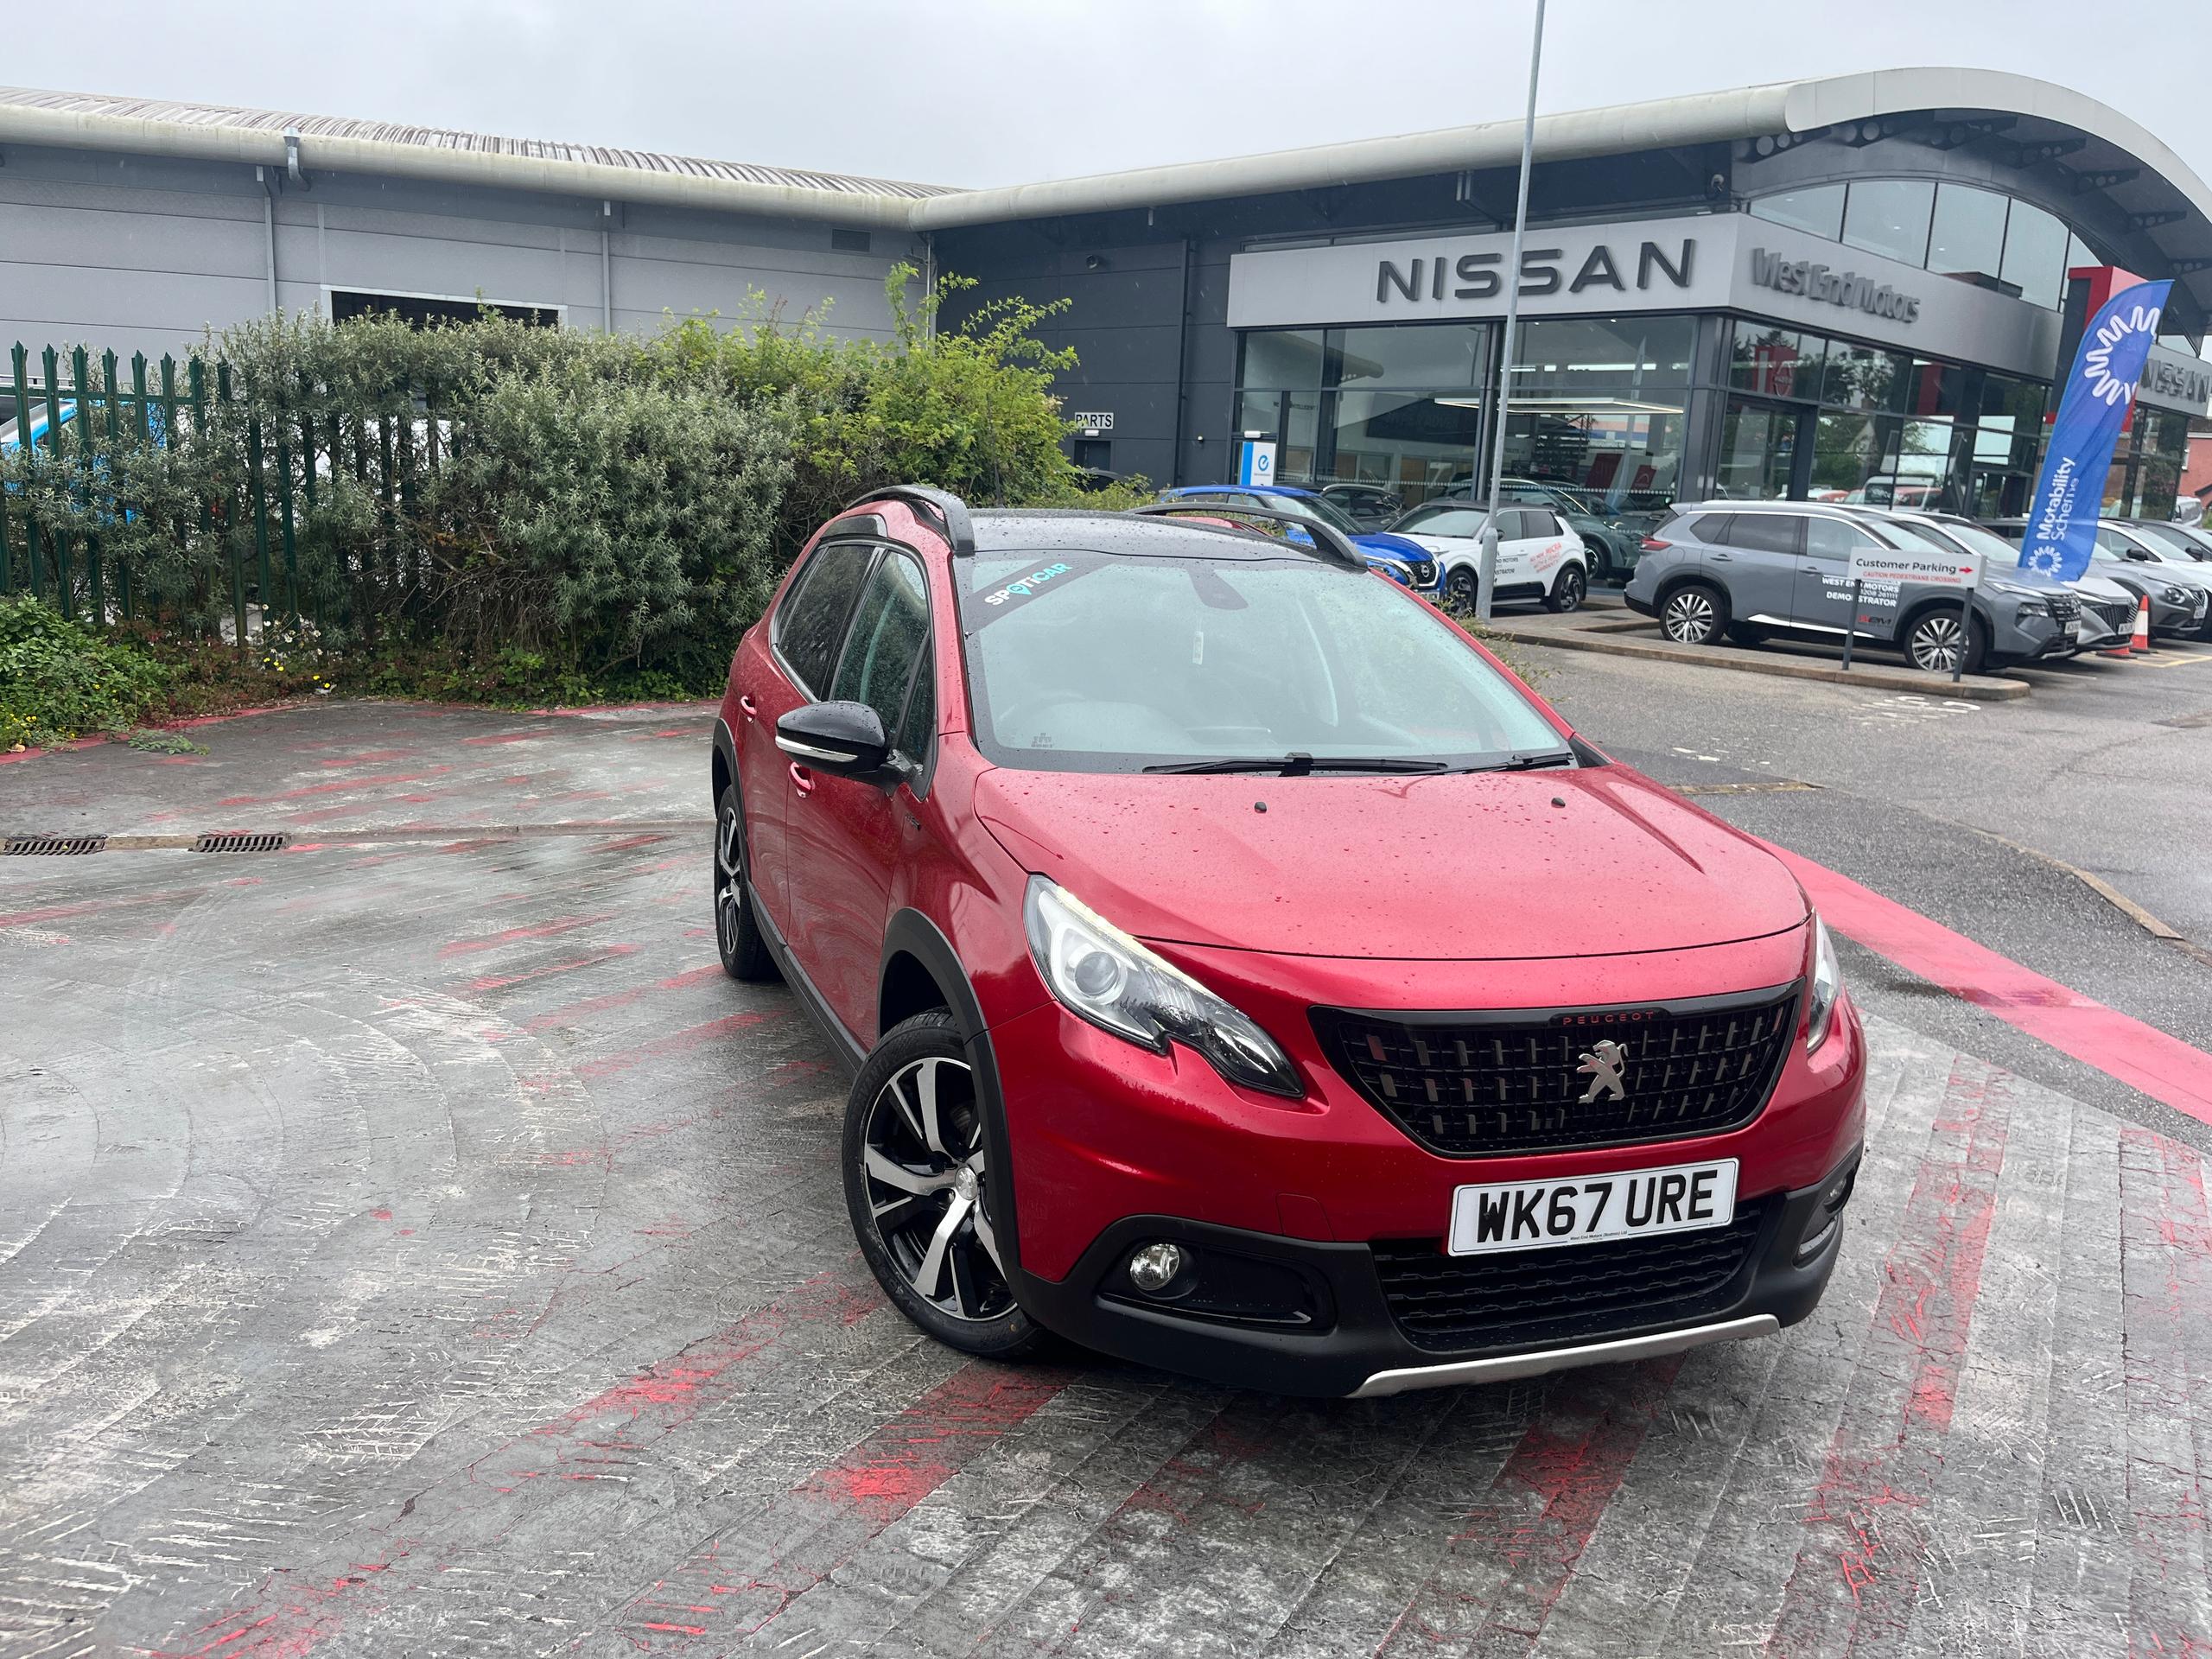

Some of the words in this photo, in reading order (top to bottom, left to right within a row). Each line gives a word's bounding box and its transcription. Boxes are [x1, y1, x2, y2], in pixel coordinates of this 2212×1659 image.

[1376, 238, 1696, 302] NISSAN
[1752, 247, 1809, 296] West
[1808, 264, 1856, 308] End
[1855, 276, 1921, 323] Motors
[2141, 359, 2210, 404] NISSAN
[1076, 414, 1112, 428] PARTS
[2037, 456, 2075, 541] Motability
[1856, 558, 1910, 570] Customer
[1912, 563, 1957, 575] Parking
[1821, 576, 1845, 587] WEST
[1863, 582, 1899, 594] MOTORS
[1889, 573, 1929, 582] PEDESTRIANS
[1826, 591, 1897, 607] DEMOSTRATOR
[1562, 1011, 1654, 1026] PEUGEOT
[1477, 1182, 1612, 1243] WK67
[1625, 1169, 1719, 1227] URE
